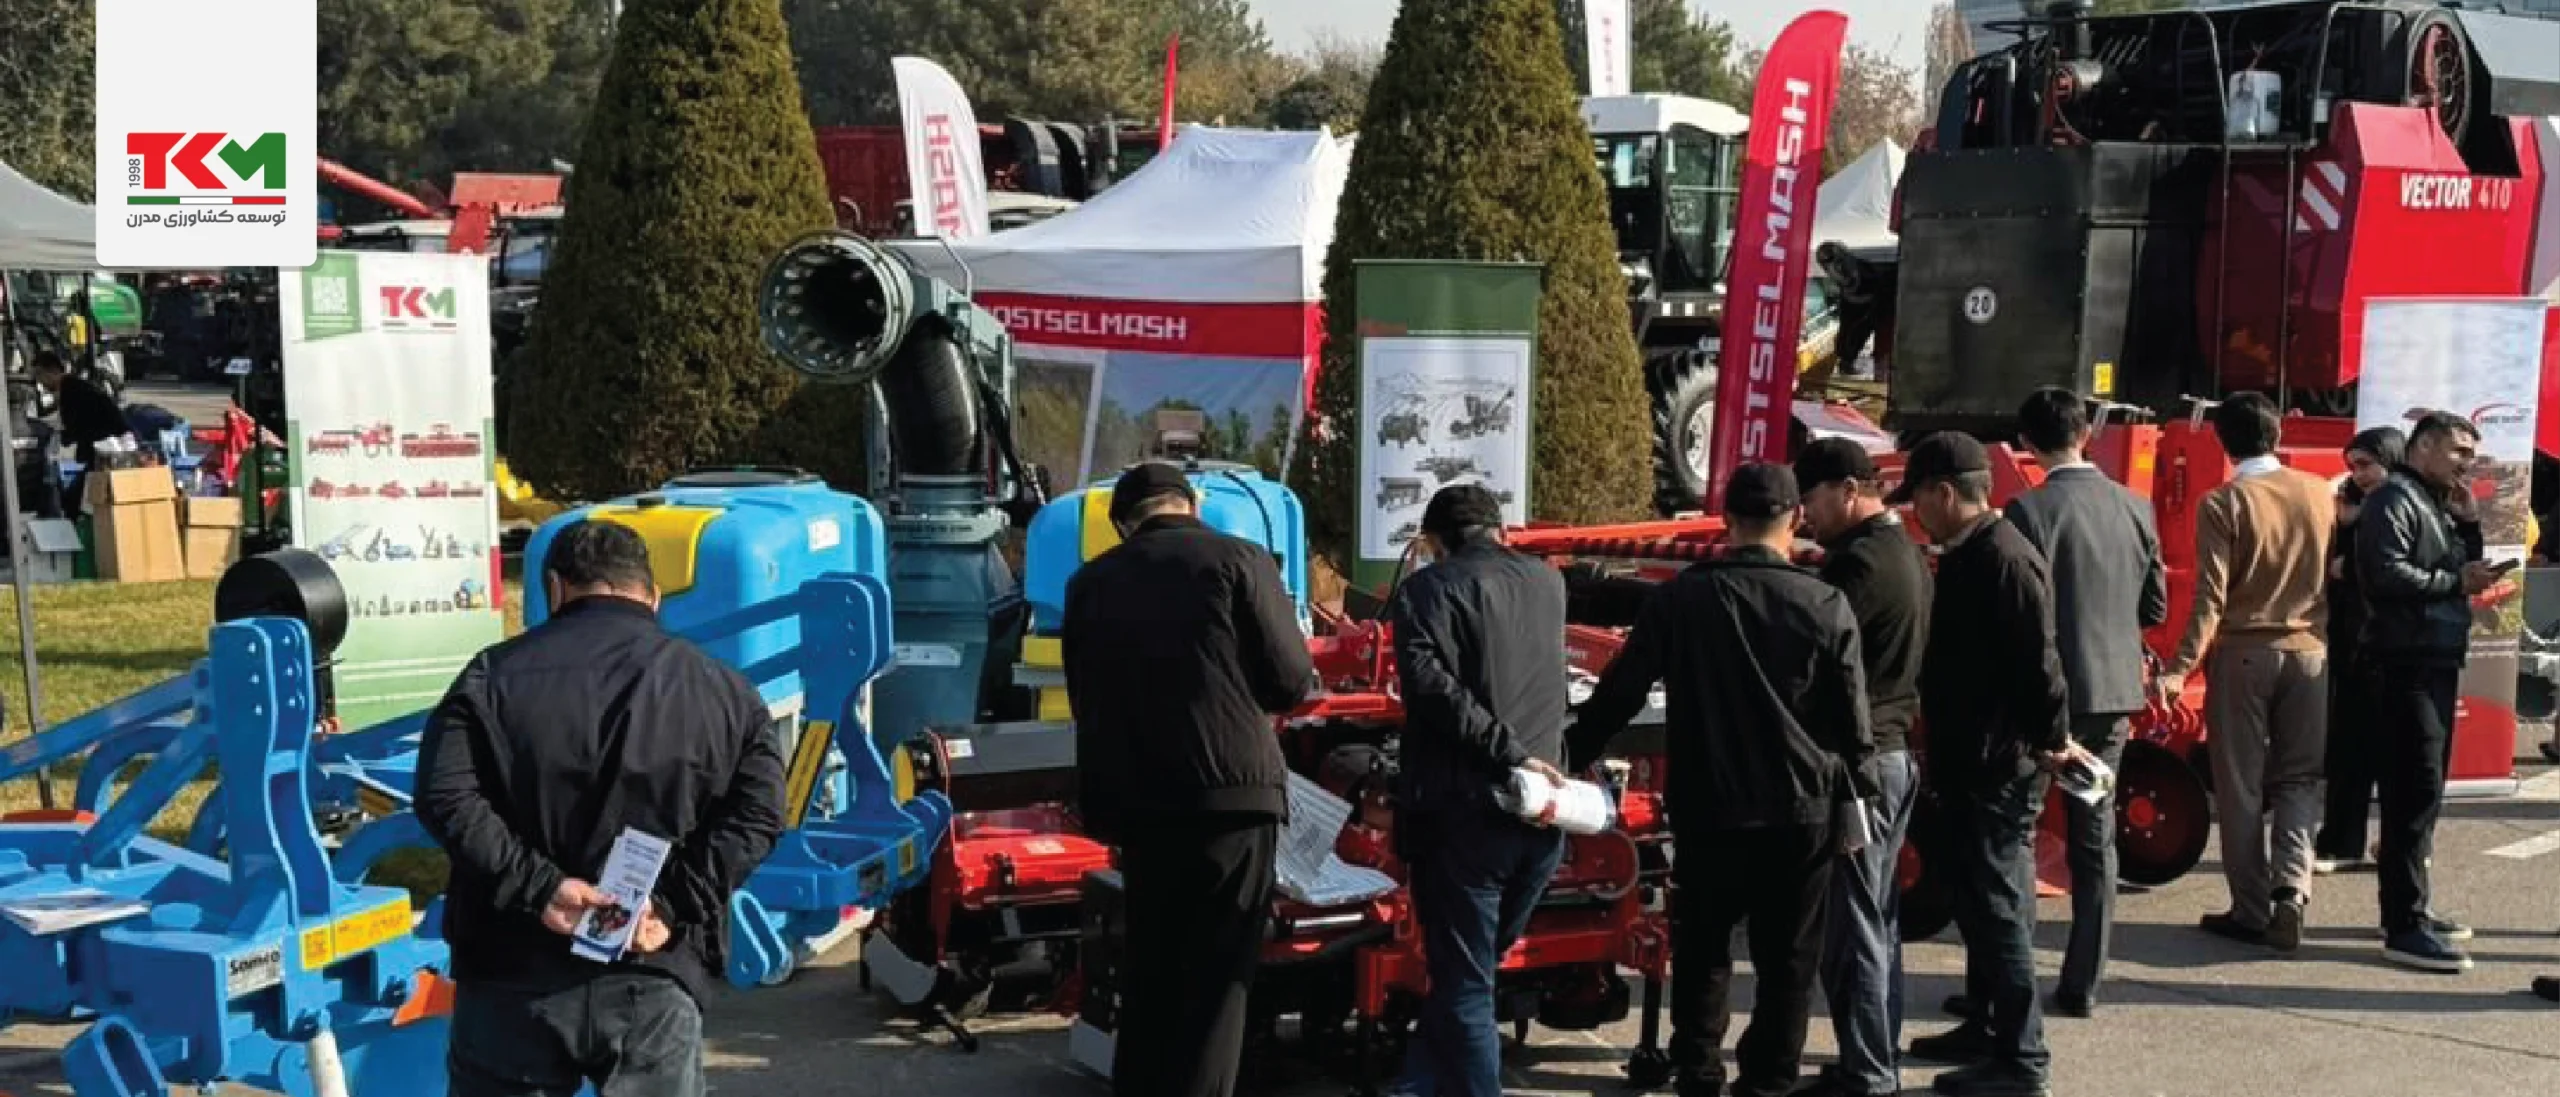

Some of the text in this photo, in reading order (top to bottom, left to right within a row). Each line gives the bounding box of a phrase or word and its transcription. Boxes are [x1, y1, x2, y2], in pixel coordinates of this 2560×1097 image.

[2401, 172, 2513, 211] VECTOR 410
[1742, 77, 1811, 464] STSELMASH
[380, 286, 456, 318] TKM
[1971, 295, 1991, 314] 20
[991, 305, 1187, 340] OSTSELMASH
